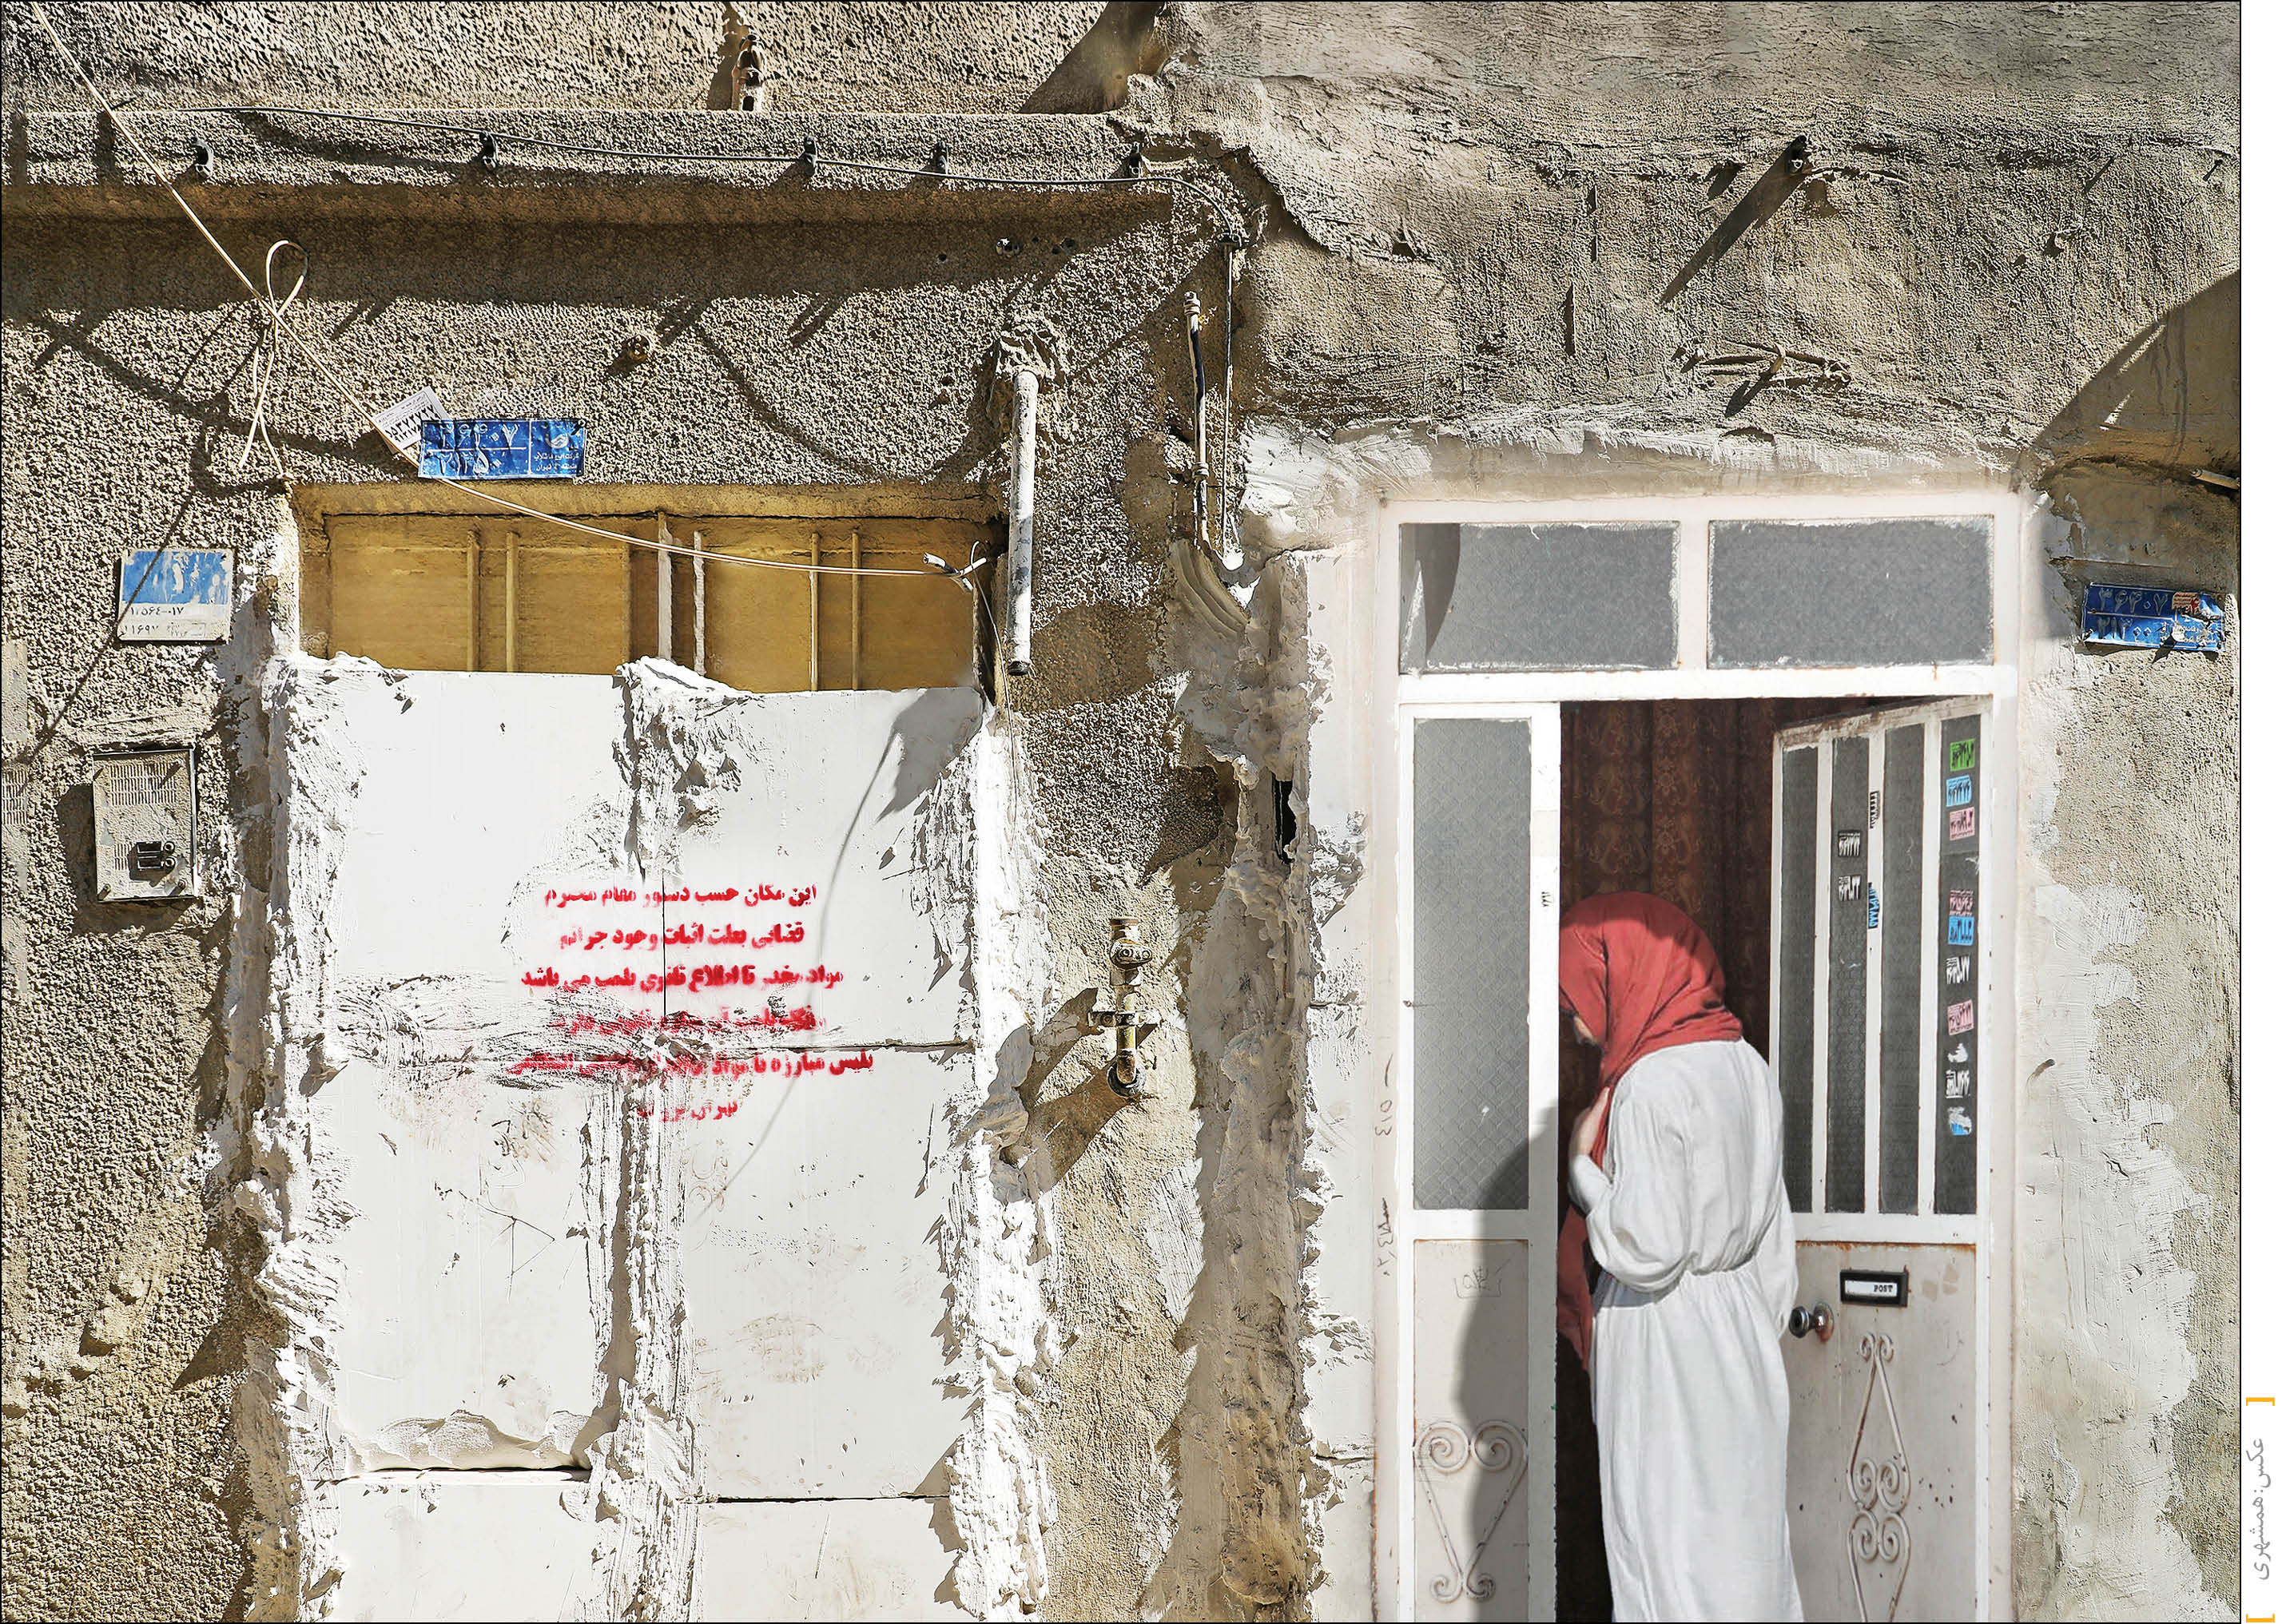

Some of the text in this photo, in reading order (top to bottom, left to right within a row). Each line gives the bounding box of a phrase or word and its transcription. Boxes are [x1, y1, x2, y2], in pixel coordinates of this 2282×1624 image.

[694, 887, 739, 906] حسب
[744, 883, 785, 907] مکان
[788, 883, 817, 907] این
[805, 964, 845, 990] مواد
